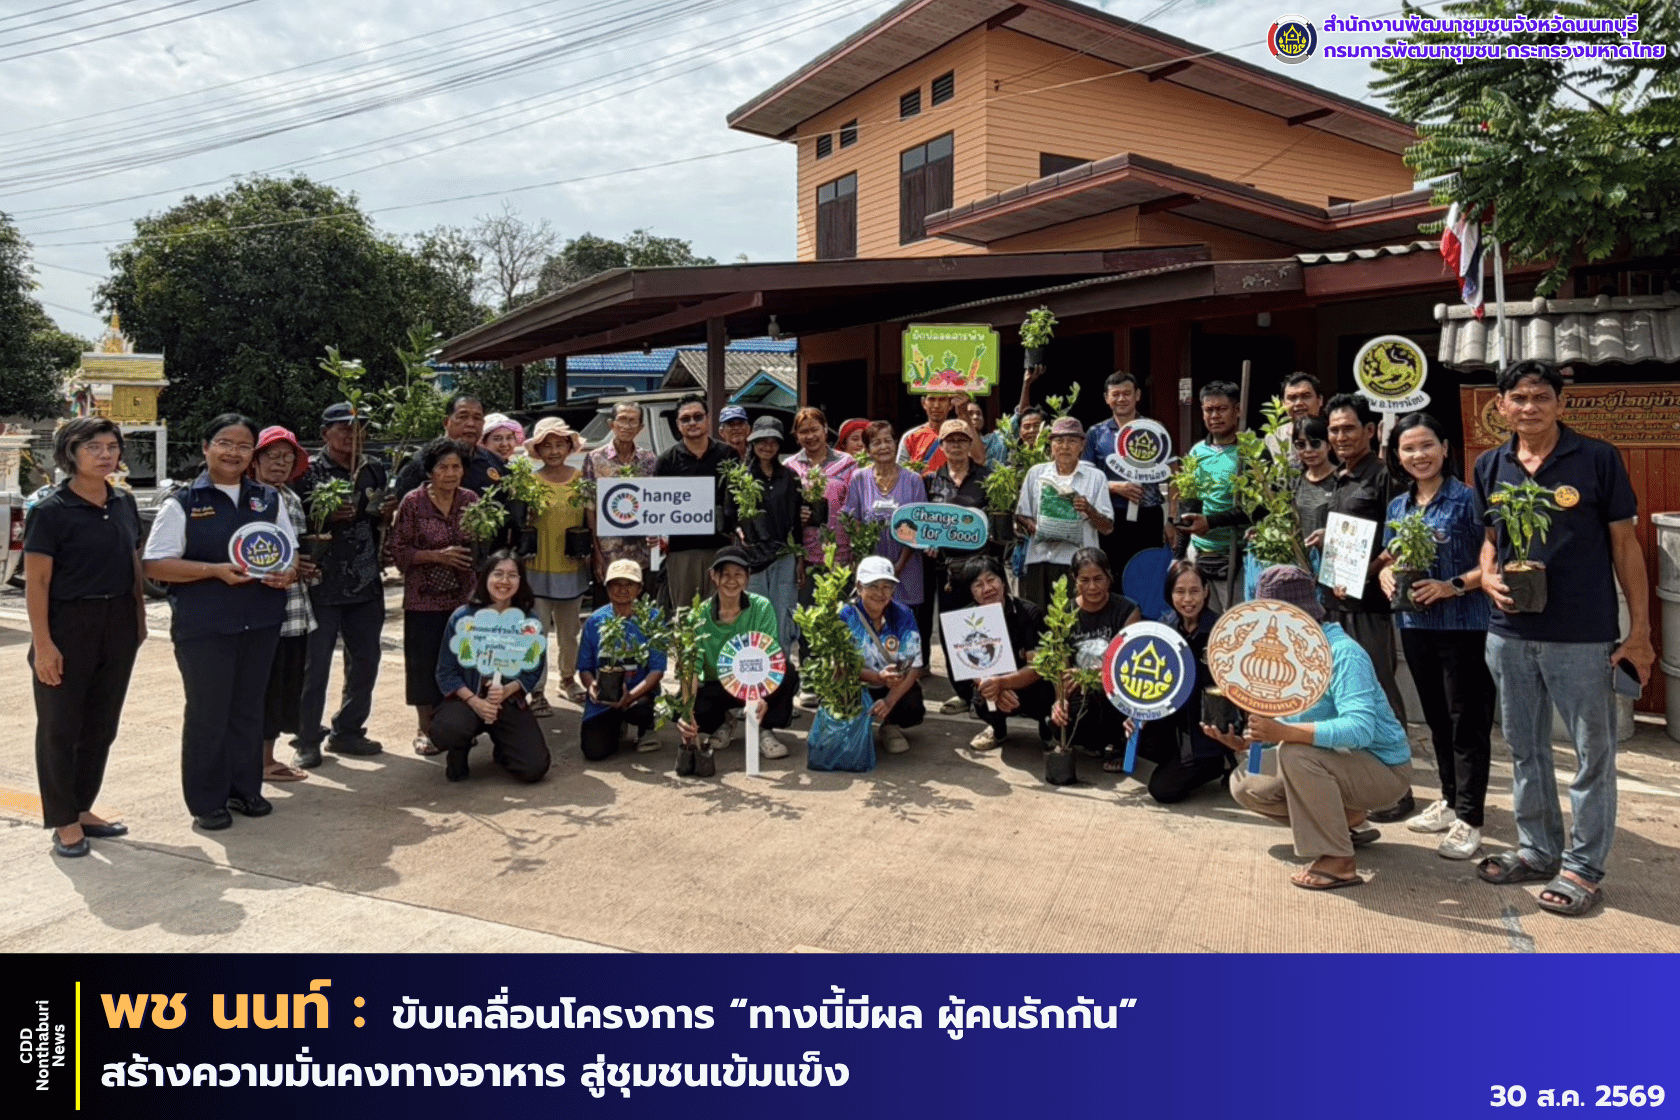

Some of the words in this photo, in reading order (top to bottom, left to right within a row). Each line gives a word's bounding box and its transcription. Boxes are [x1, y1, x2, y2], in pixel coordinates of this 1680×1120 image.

[642, 509, 666, 524] for
[669, 509, 714, 524] Good
[911, 507, 959, 529] Change
[921, 524, 941, 540] for
[946, 526, 981, 543] Good
